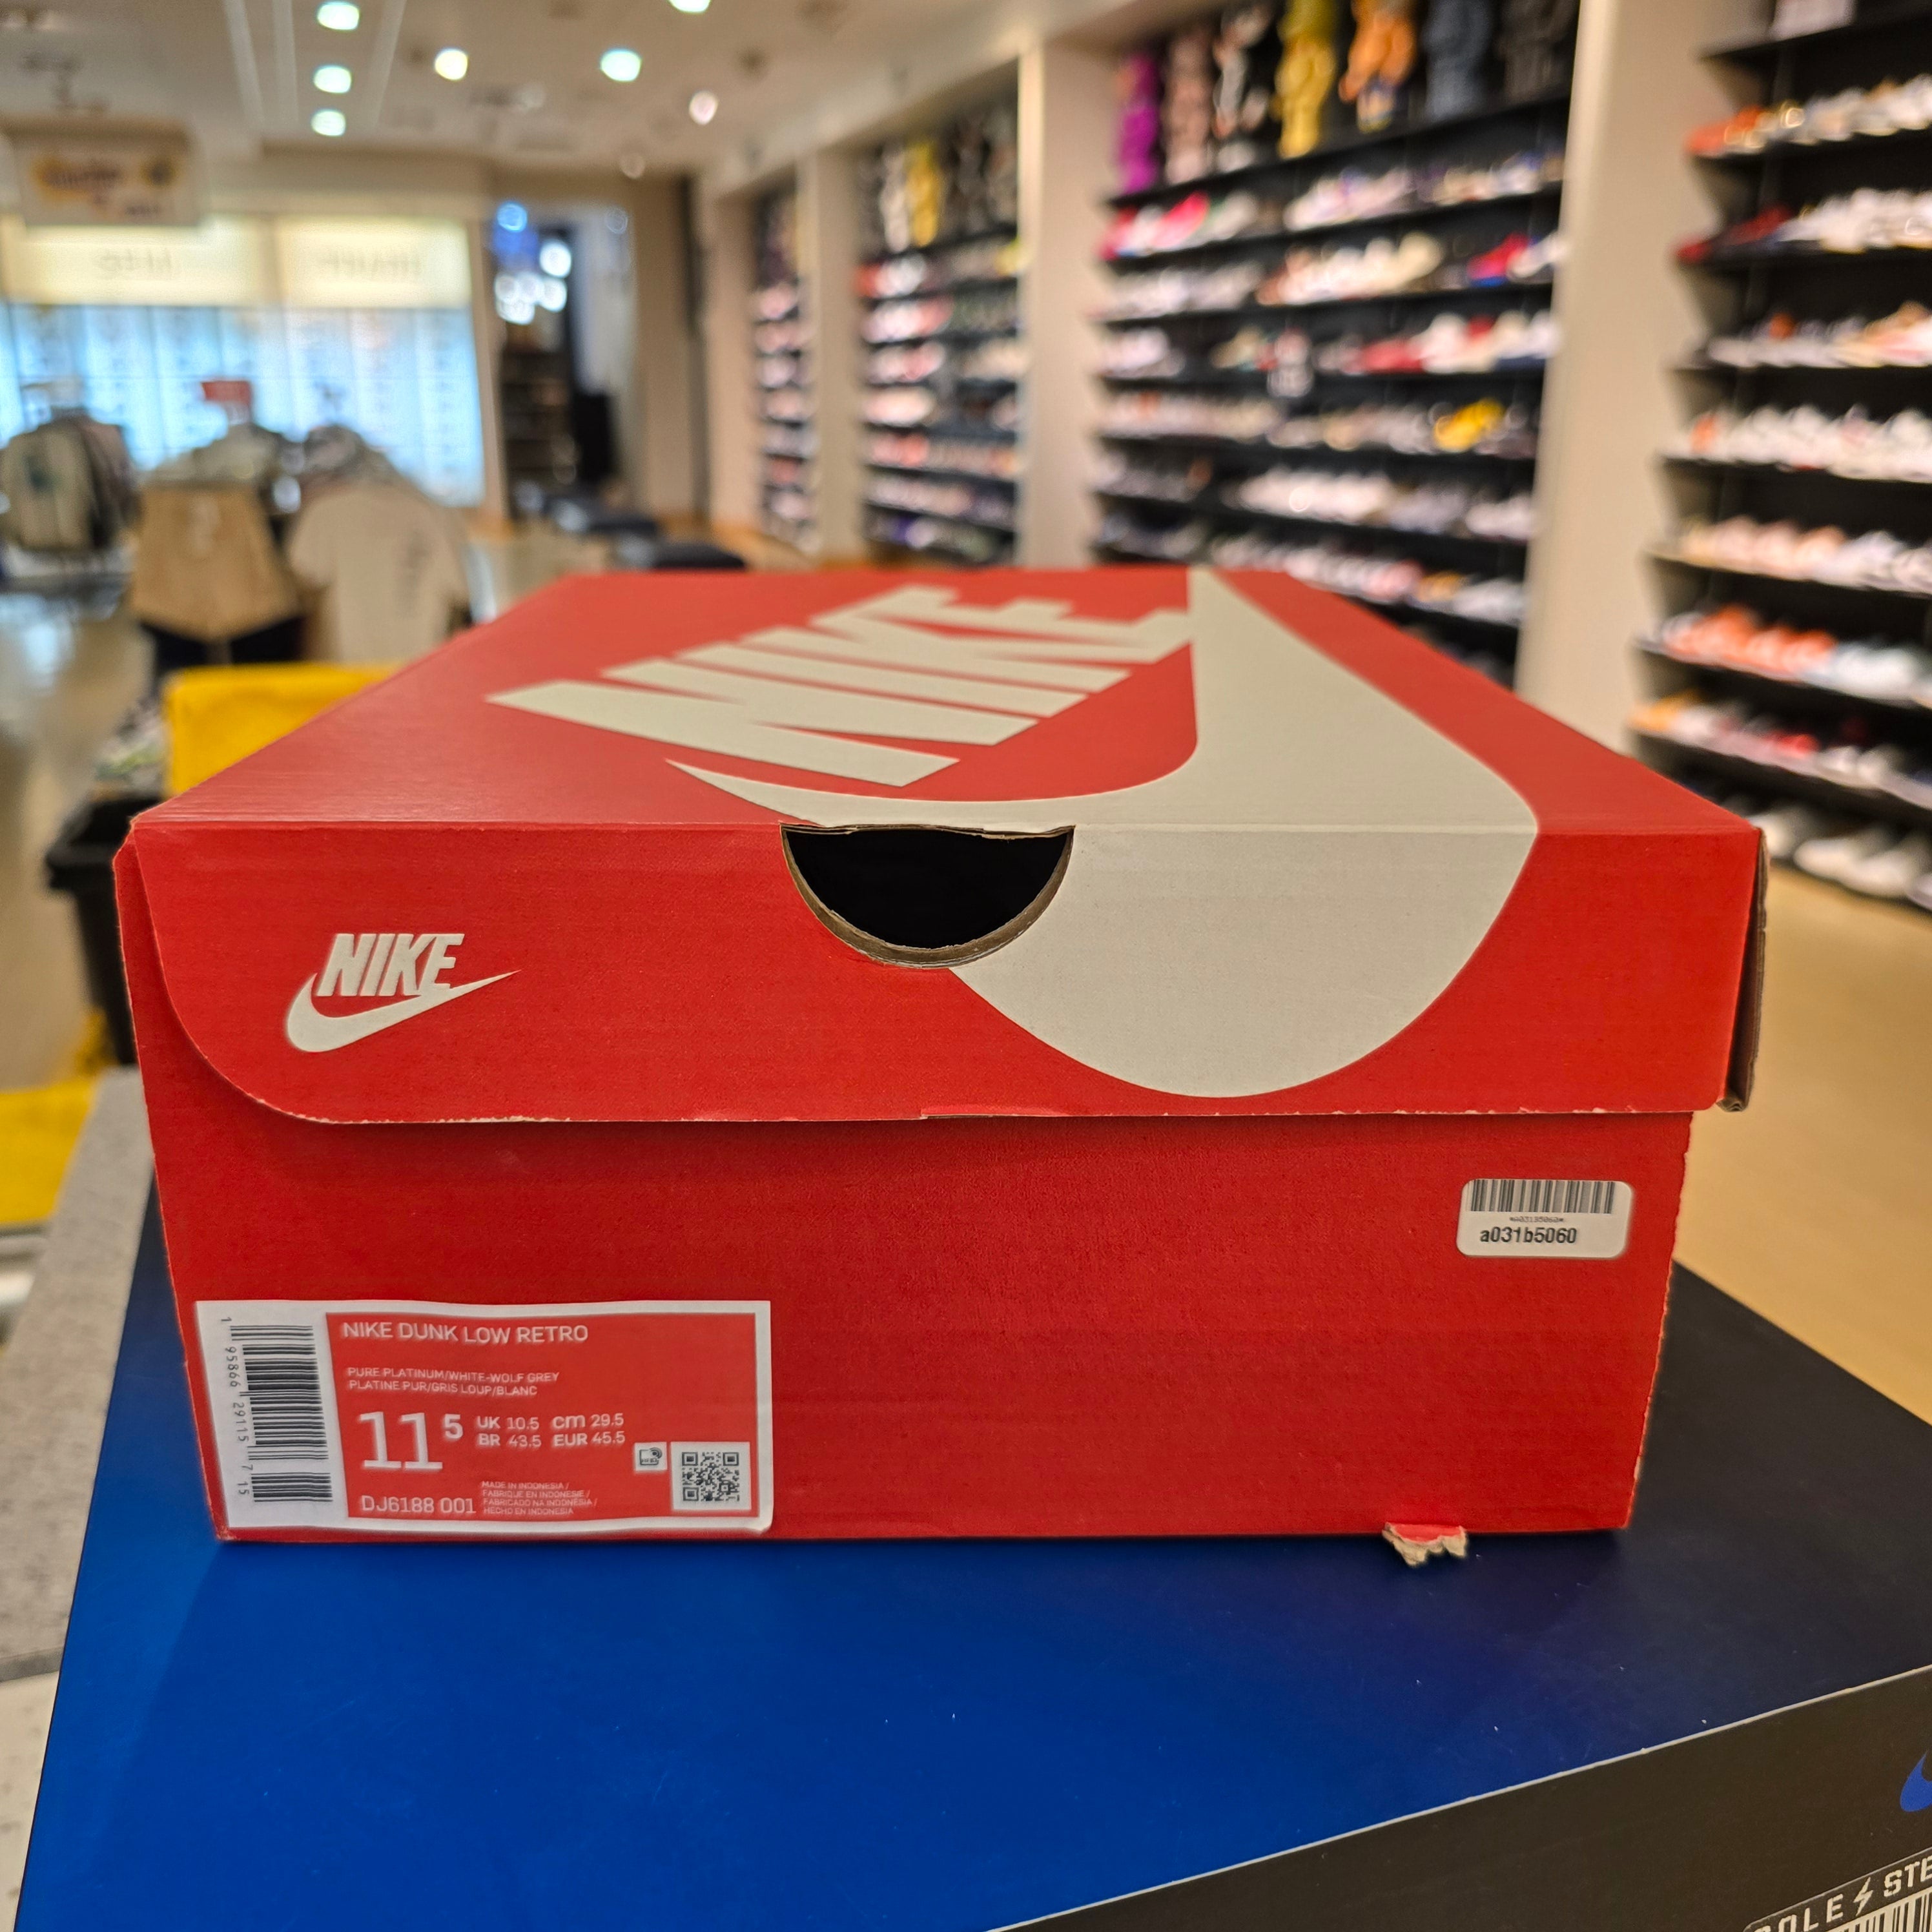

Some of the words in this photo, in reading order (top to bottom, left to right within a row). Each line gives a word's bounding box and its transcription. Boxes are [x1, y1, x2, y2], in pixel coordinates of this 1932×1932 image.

[484, 584, 1190, 787] NIKE
[316, 933, 465, 996] NIKE
[1480, 1226, 1577, 1244] a031b5060
[343, 1322, 393, 1338] NIKE
[399, 1323, 458, 1341] DUNK
[464, 1326, 510, 1343] LOW
[517, 1325, 588, 1342] RETRO
[225, 1346, 241, 1388] 95866
[347, 1367, 380, 1377] PURE
[384, 1368, 524, 1382] PLATINUM/WHITE-WOLF
[528, 1372, 559, 1382] GREY
[349, 1380, 400, 1391] PLATINE
[403, 1381, 458, 1393] PUR/GRIS
[461, 1384, 537, 1397] LOUP/BLANC
[232, 1402, 249, 1442] 29115
[477, 1415, 500, 1430] UK
[507, 1417, 539, 1431] 10.5
[552, 1414, 585, 1429] cm
[591, 1413, 624, 1426] 29.5
[360, 1411, 442, 1470] 11
[444, 1413, 463, 1439] 5
[478, 1434, 500, 1447] BR
[508, 1434, 541, 1448] 43.5
[554, 1432, 588, 1447] EUR
[590, 1431, 625, 1445] 45.5
[237, 1481, 250, 1495] 15
[482, 1490, 524, 1498] FABRIQUE
[361, 1495, 435, 1514] DJ6188
[440, 1497, 477, 1514] 001
[483, 1498, 531, 1506] FABRICADO
[484, 1506, 513, 1515] HECHO
[1753, 1893, 1844, 1932] OLE
